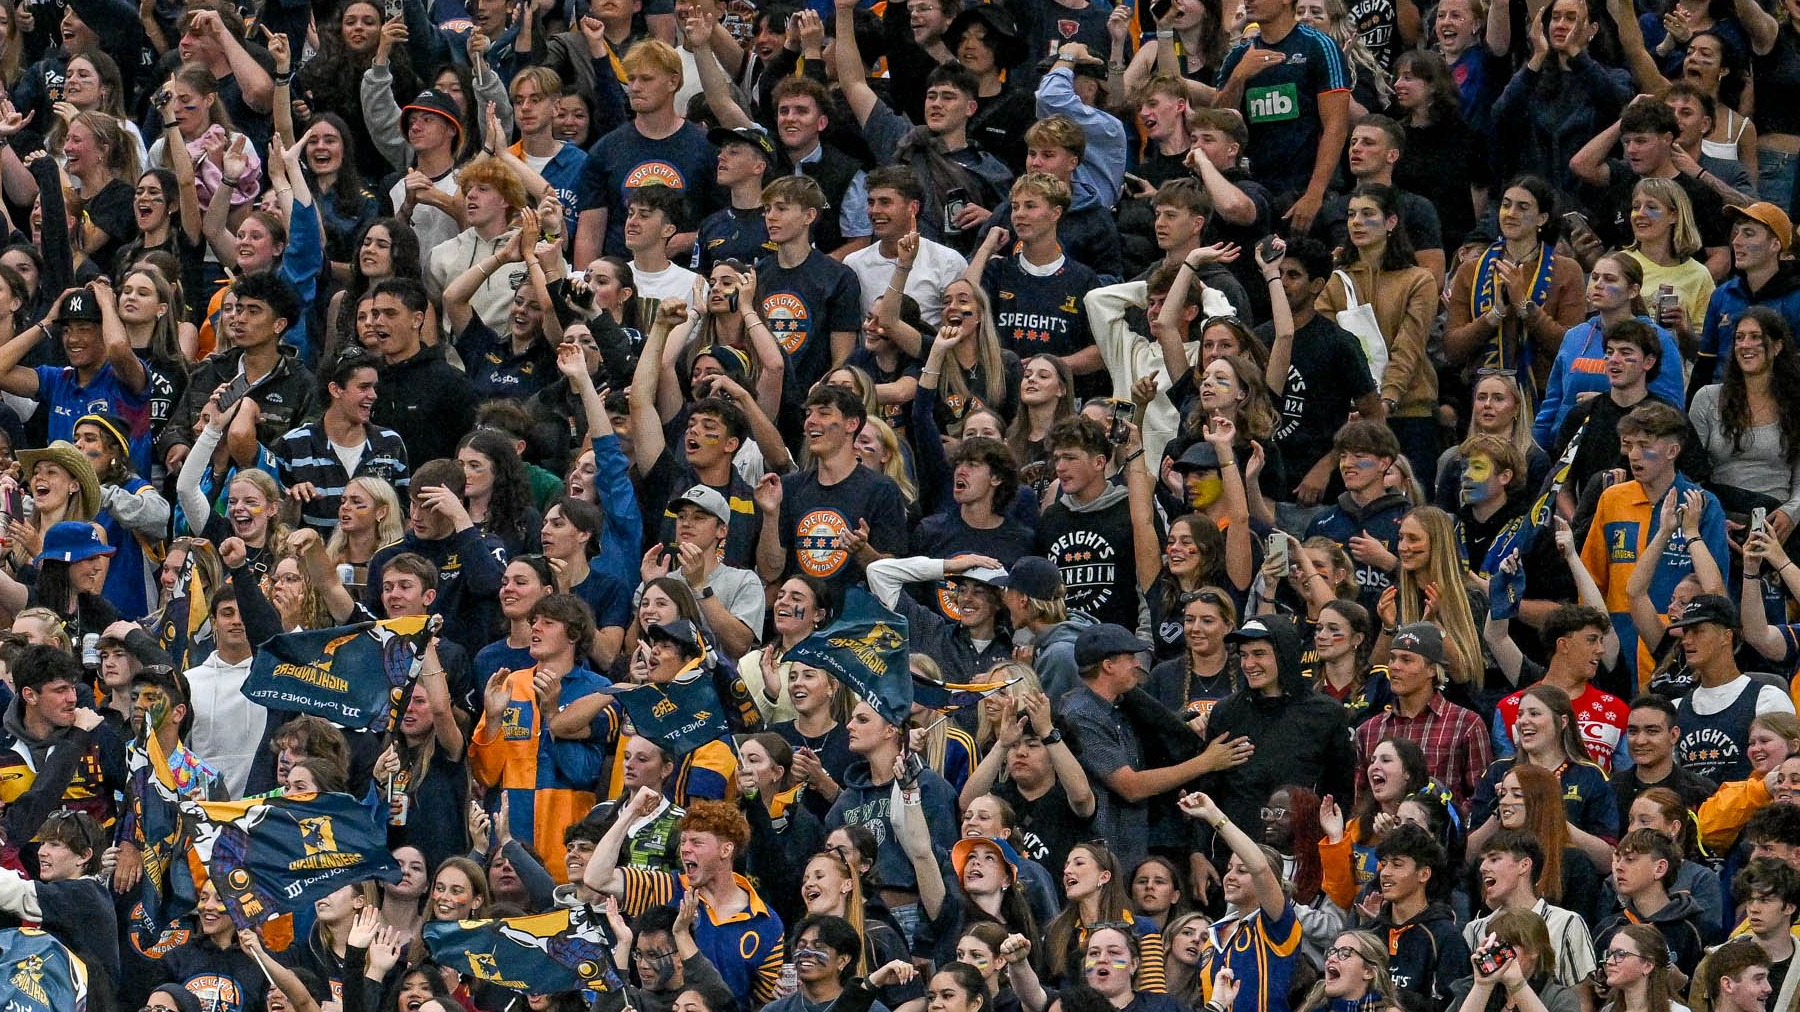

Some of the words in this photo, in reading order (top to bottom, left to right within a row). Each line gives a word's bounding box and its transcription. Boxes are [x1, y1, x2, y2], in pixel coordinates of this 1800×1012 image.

[1250, 90, 1293, 117] nib
[629, 164, 678, 185] SPEIGHT'S
[998, 313, 1068, 334] SPEIGHT'S
[799, 512, 845, 535] SPEIGHT'S
[1048, 530, 1116, 566] SPEIGHT'S
[1355, 565, 1391, 588] sbs
[1680, 728, 1739, 758] SPEIGHT'S
